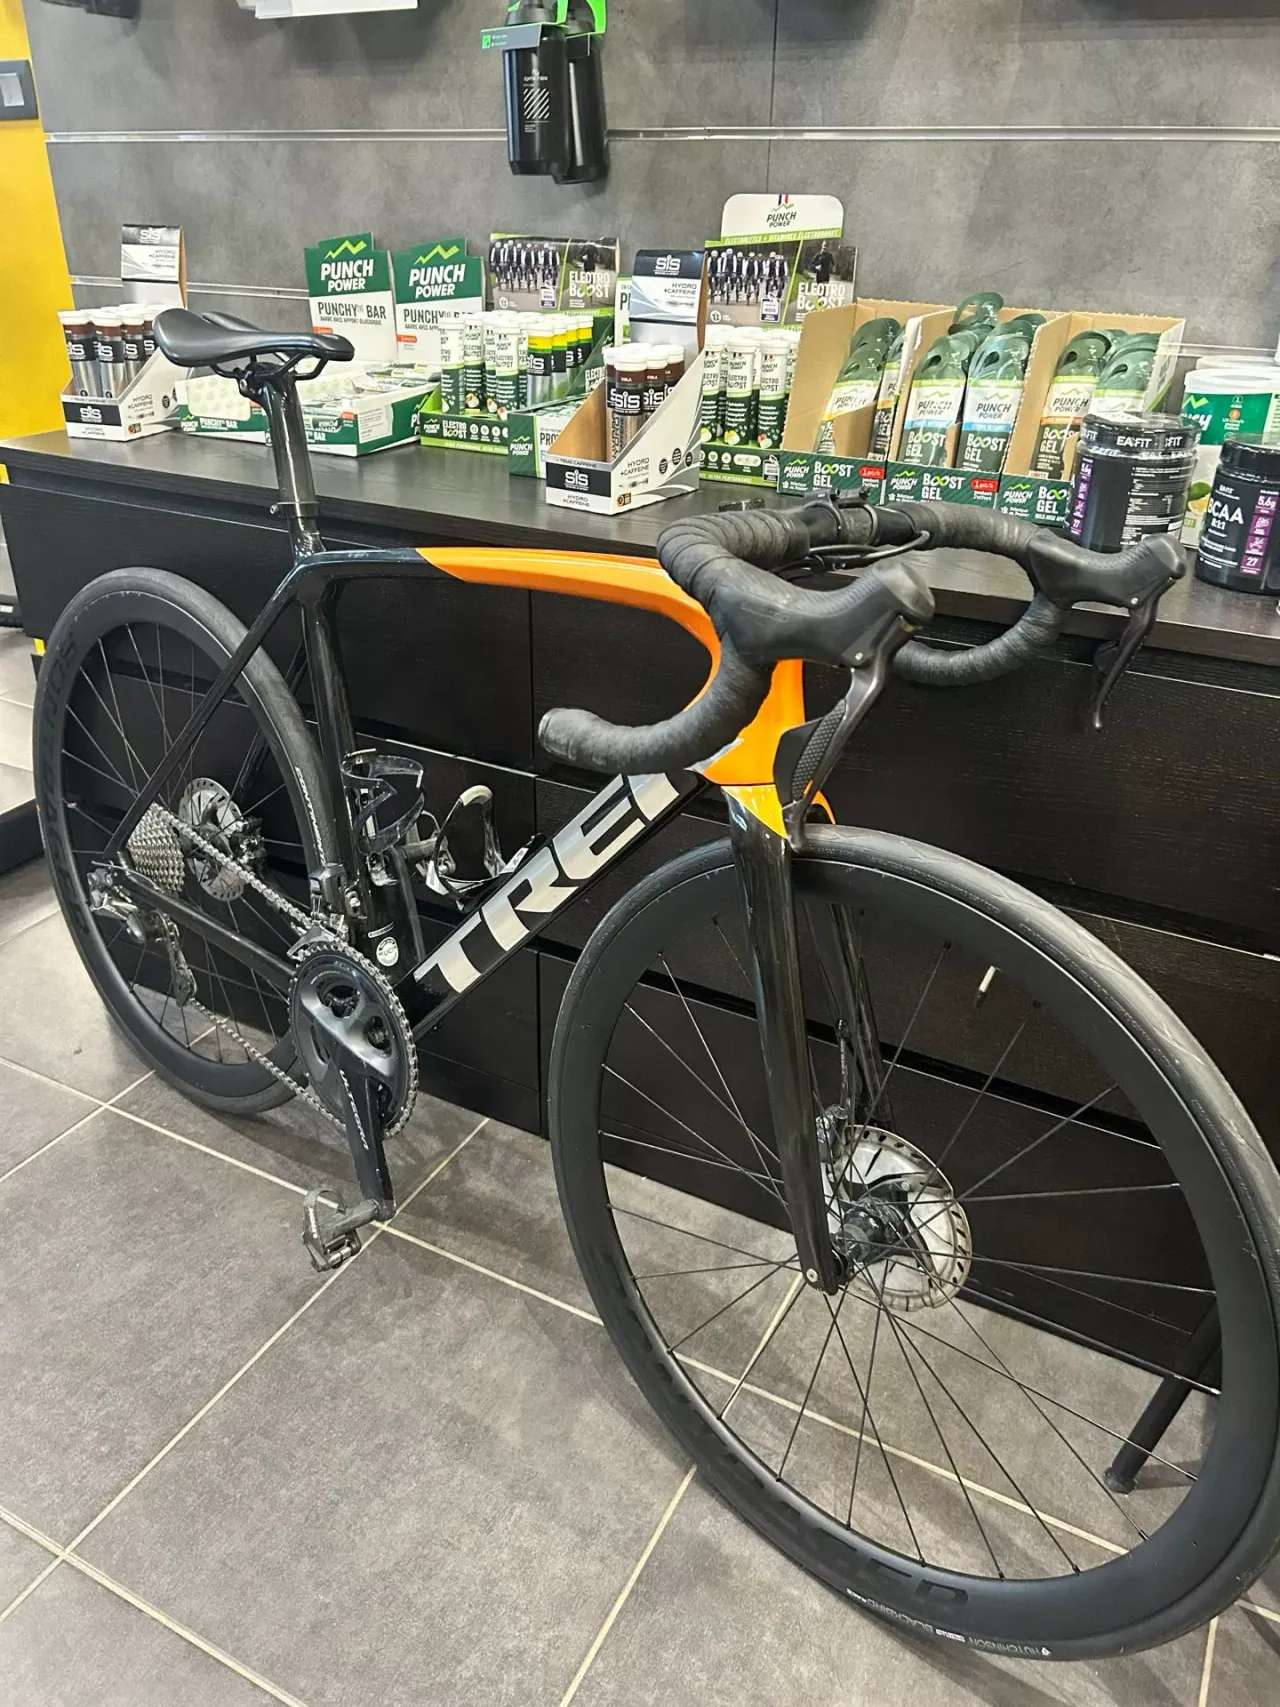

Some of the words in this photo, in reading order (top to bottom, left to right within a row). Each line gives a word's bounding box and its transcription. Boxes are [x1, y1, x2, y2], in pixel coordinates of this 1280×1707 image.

[766, 211, 797, 223] PUNCH
[321, 259, 374, 281] PUNCH
[409, 263, 467, 287] PUNCH
[569, 271, 611, 284] ELECTRO
[328, 278, 366, 293] POWER
[415, 283, 456, 299] POWER
[569, 281, 610, 298] BOOST
[798, 282, 846, 297] ELECTRO
[318, 301, 358, 317] PUNCHY
[366, 305, 387, 320] BAR
[976, 403, 1012, 413] PUNCH
[442, 419, 468, 430] ELECTRO
[442, 428, 467, 439] BOOST
[908, 431, 947, 447] BOOST
[510, 443, 533, 451] PUNCH
[966, 433, 1006, 451] BOOST
[1040, 440, 1058, 454] GEL
[905, 444, 923, 457] GEL
[964, 447, 983, 463] GEL
[628, 457, 650, 468] HYDRO
[784, 466, 810, 474] PUNCH
[814, 461, 855, 477] BOOST
[813, 474, 833, 488] GEL
[890, 477, 918, 486] PUNCH
[922, 472, 967, 489] BOOST
[921, 485, 942, 500] GEL
[1002, 490, 1034, 499] PUNCH
[1036, 499, 1059, 515] GEL
[339, 1069, 370, 1150] ULTEGRA
[867, 1599, 934, 1632] BLACKBIRD
[968, 1636, 1042, 1655] HUTCHINSON
